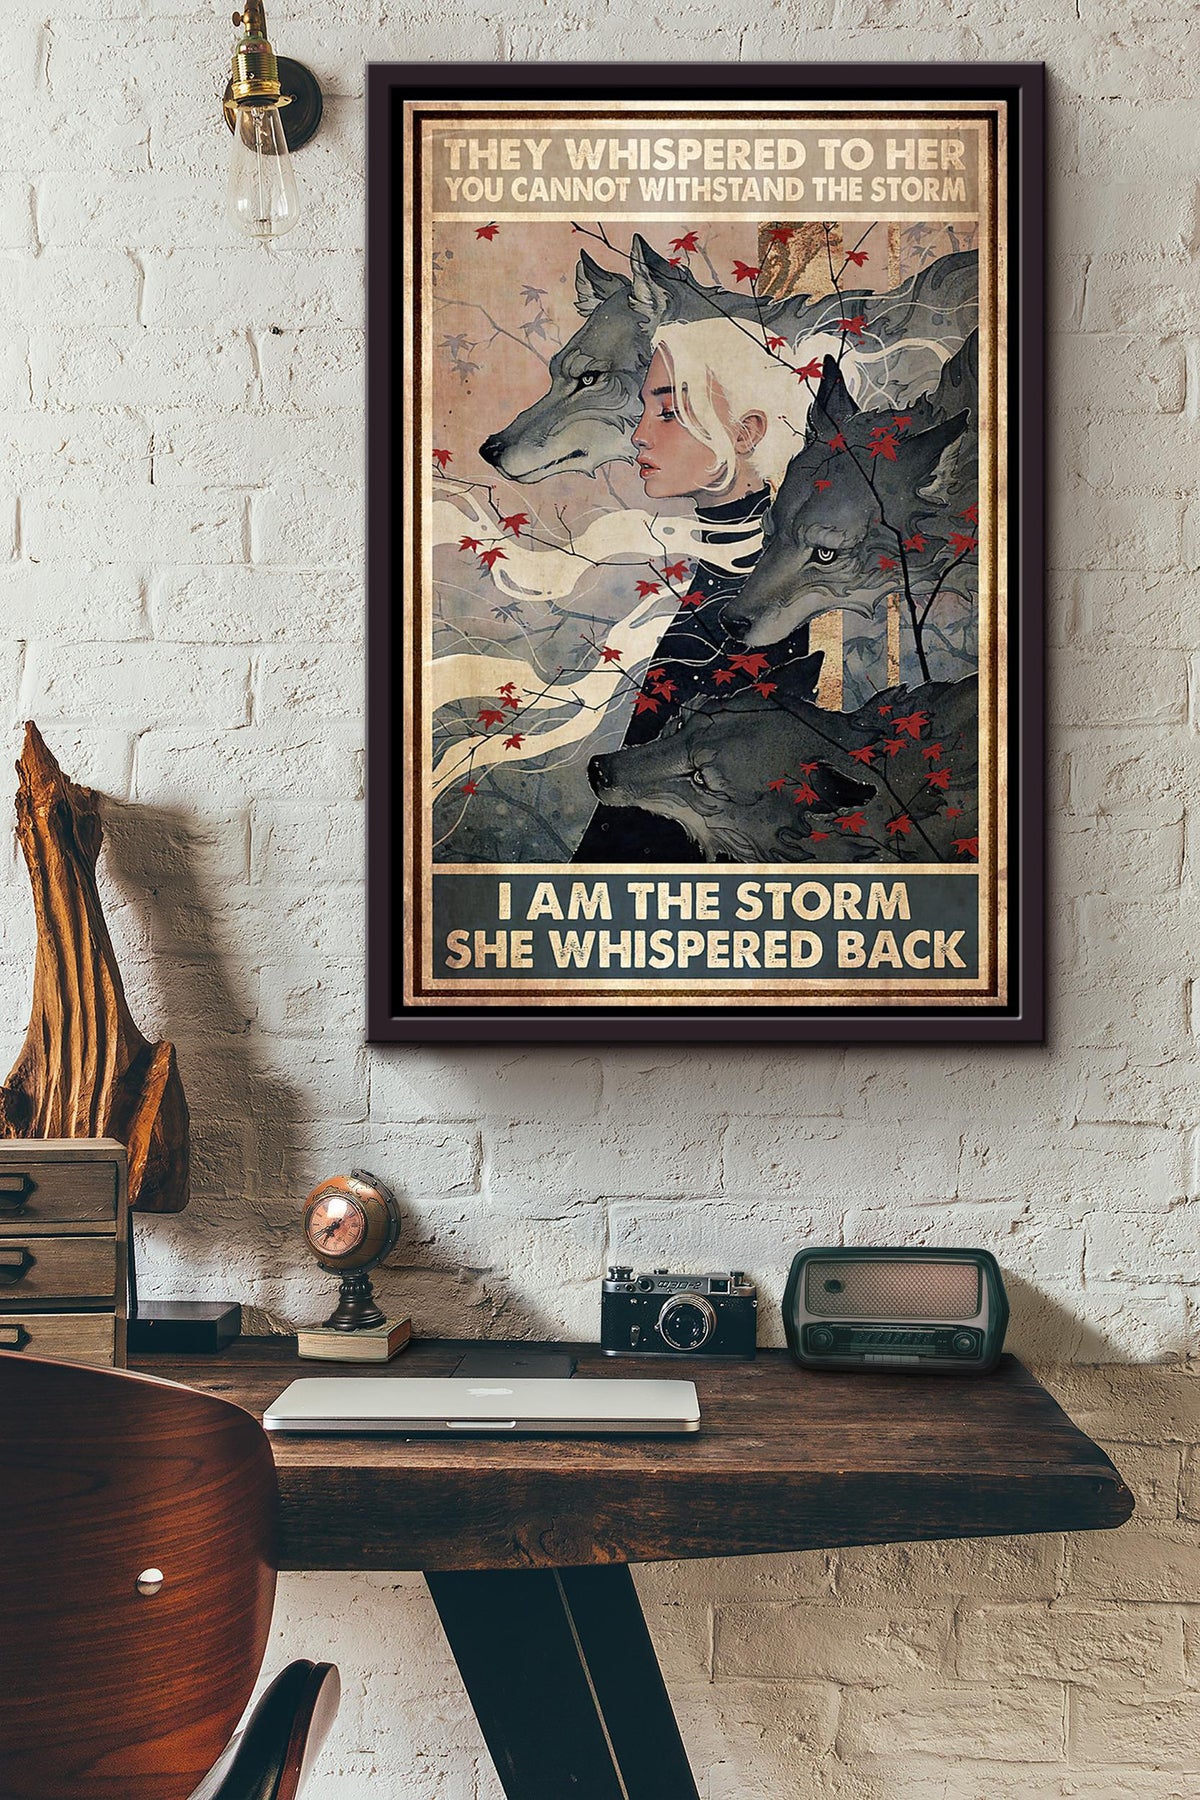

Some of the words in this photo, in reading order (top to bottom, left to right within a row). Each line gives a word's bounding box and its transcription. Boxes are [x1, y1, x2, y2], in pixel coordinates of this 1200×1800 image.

[444, 138, 553, 171] THEY
[564, 137, 807, 171] WHISPERED
[817, 137, 874, 171] TO
[886, 138, 966, 171] HER
[444, 176, 504, 203] YOU
[510, 176, 631, 203] CANNOT
[637, 176, 805, 203] WITHSTAND
[811, 176, 863, 203] THE
[870, 176, 966, 203] STORM
[497, 881, 512, 921] I
[525, 881, 614, 921] AM
[627, 881, 720, 921] THE
[735, 881, 912, 922] STORM
[445, 929, 534, 969] SHE
[547, 929, 824, 969] WHISPERED
[837, 929, 968, 970] BACK
